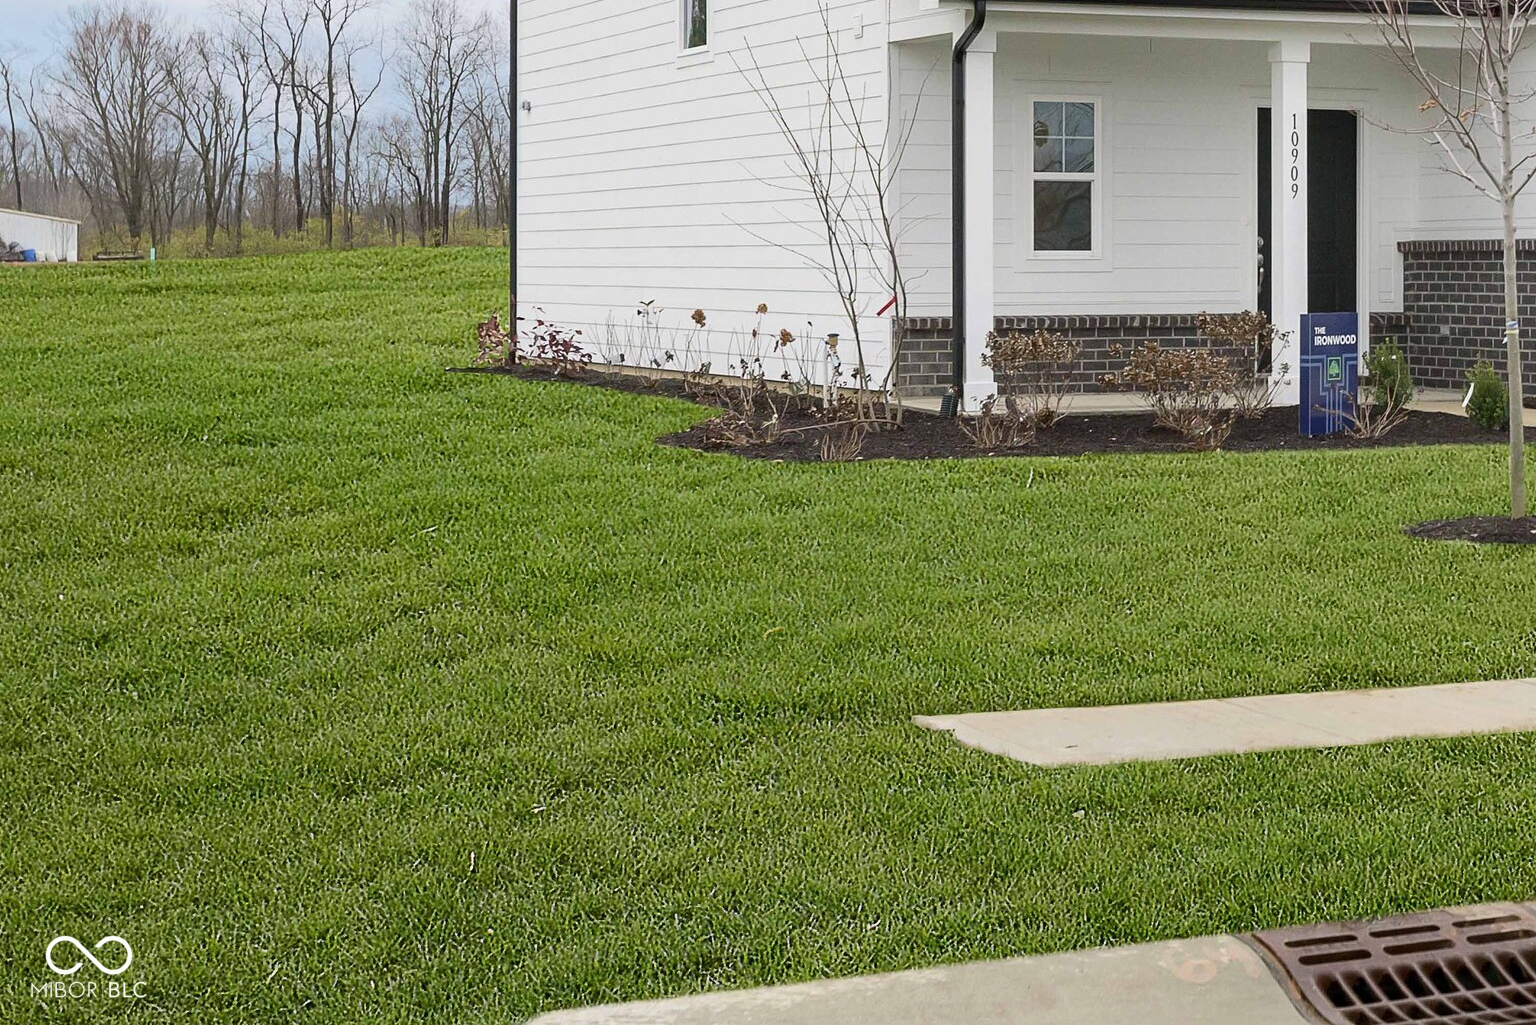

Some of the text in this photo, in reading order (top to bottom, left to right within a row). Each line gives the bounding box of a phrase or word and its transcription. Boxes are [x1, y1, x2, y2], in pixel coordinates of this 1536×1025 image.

[1290, 113, 1299, 199] 10909
[1314, 326, 1326, 334] THE
[1314, 334, 1357, 346] IRONWOOD
